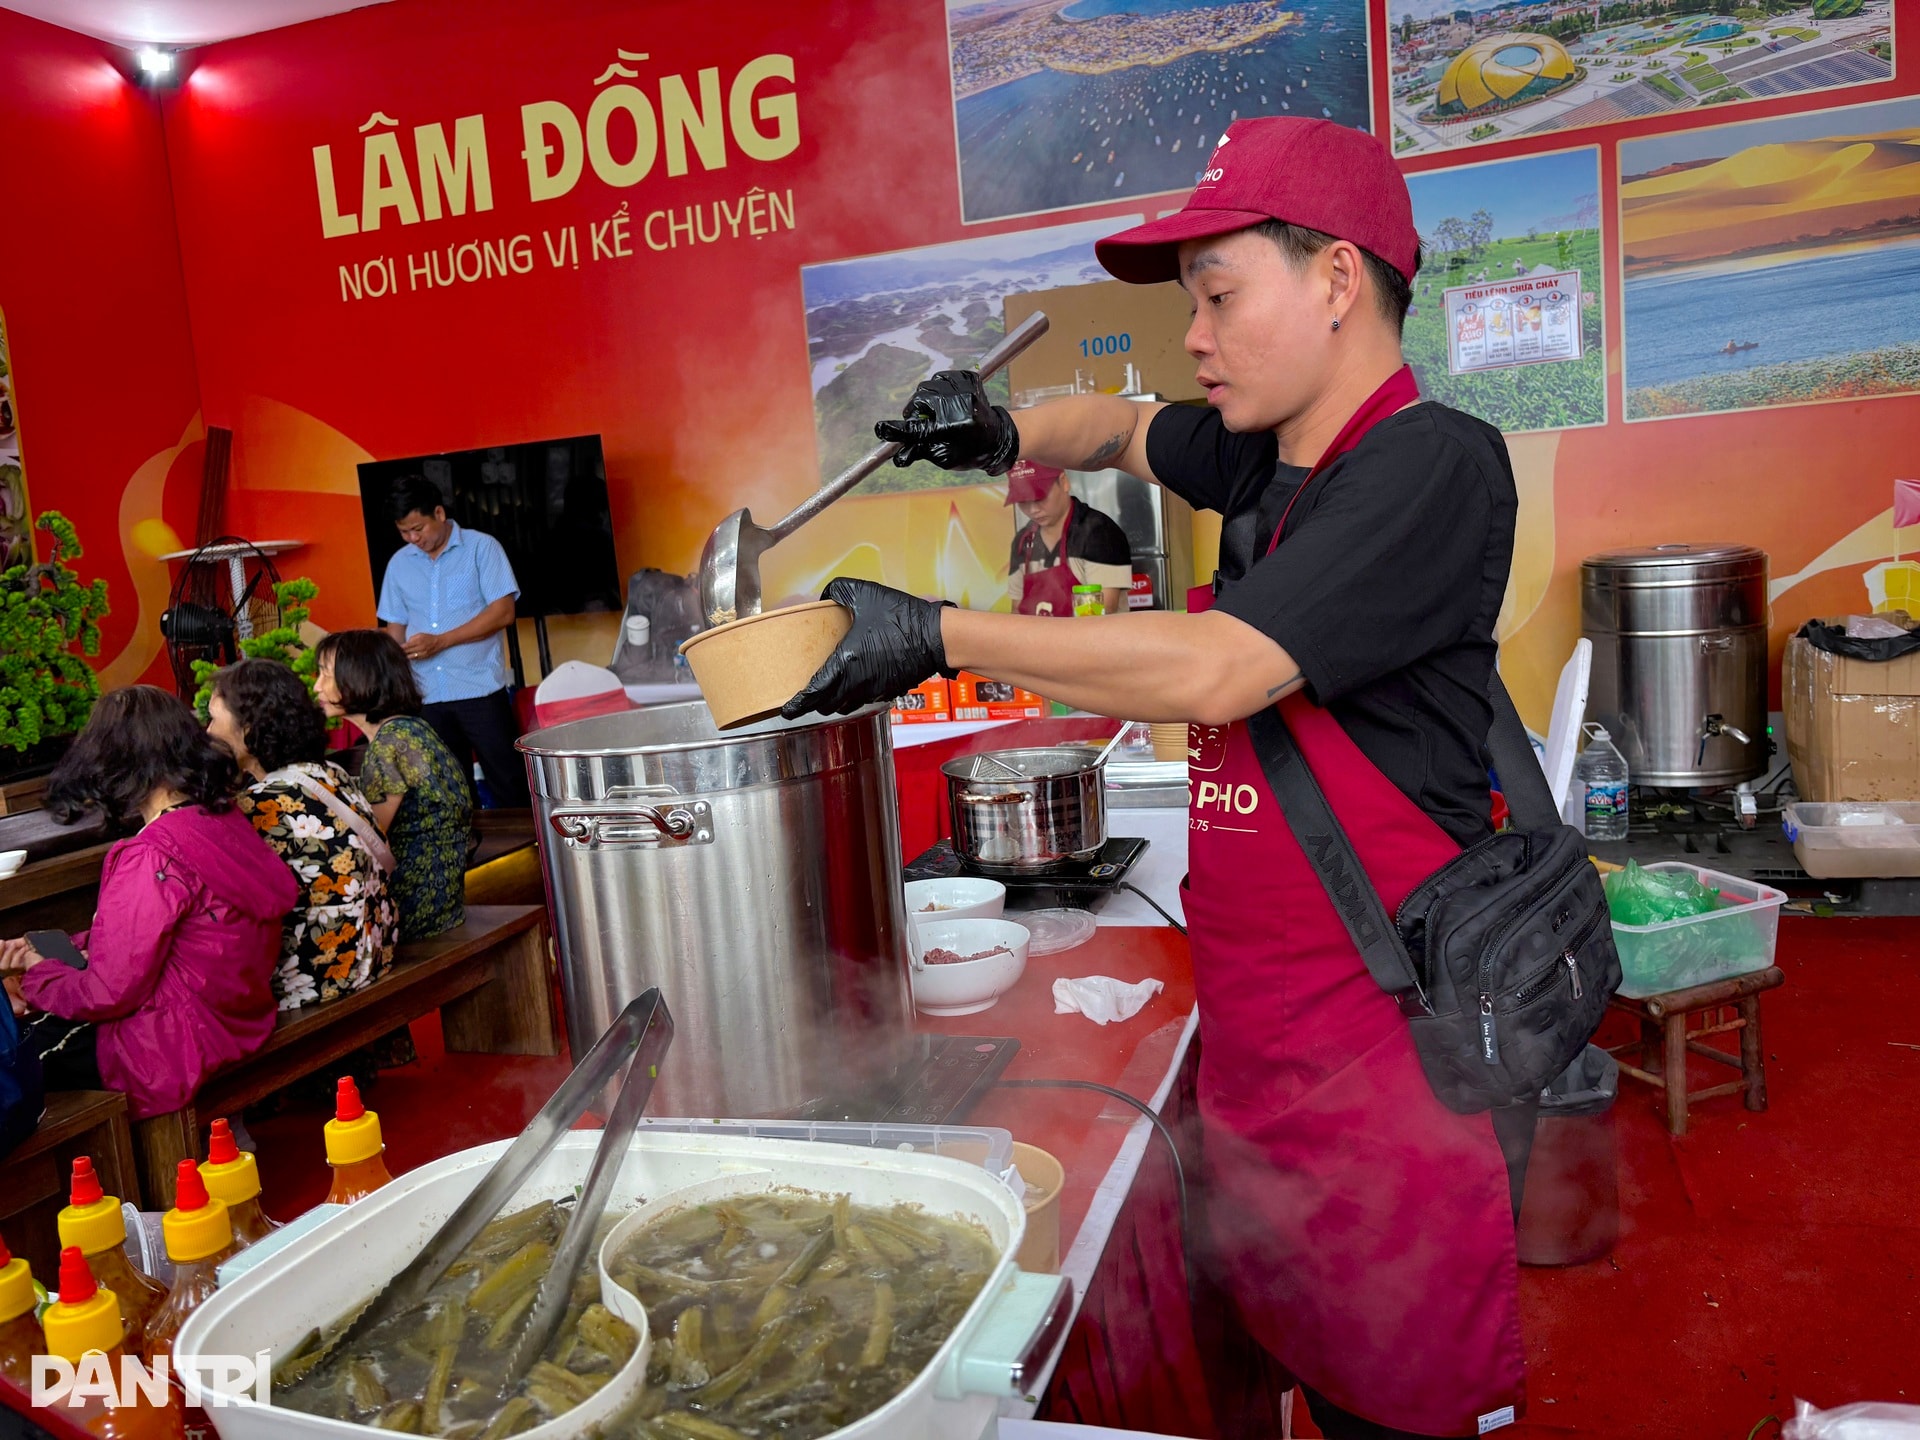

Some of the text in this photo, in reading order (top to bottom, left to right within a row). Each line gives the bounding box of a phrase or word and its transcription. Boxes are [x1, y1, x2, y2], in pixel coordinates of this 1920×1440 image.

[313, 48, 800, 239] LÂM ĐỒNG
[339, 187, 796, 302] NƠI HƯƠNG VỊ KỂ CHUYỆN
[1079, 333, 1131, 358] 1000
[1305, 832, 1381, 950] DKNY
